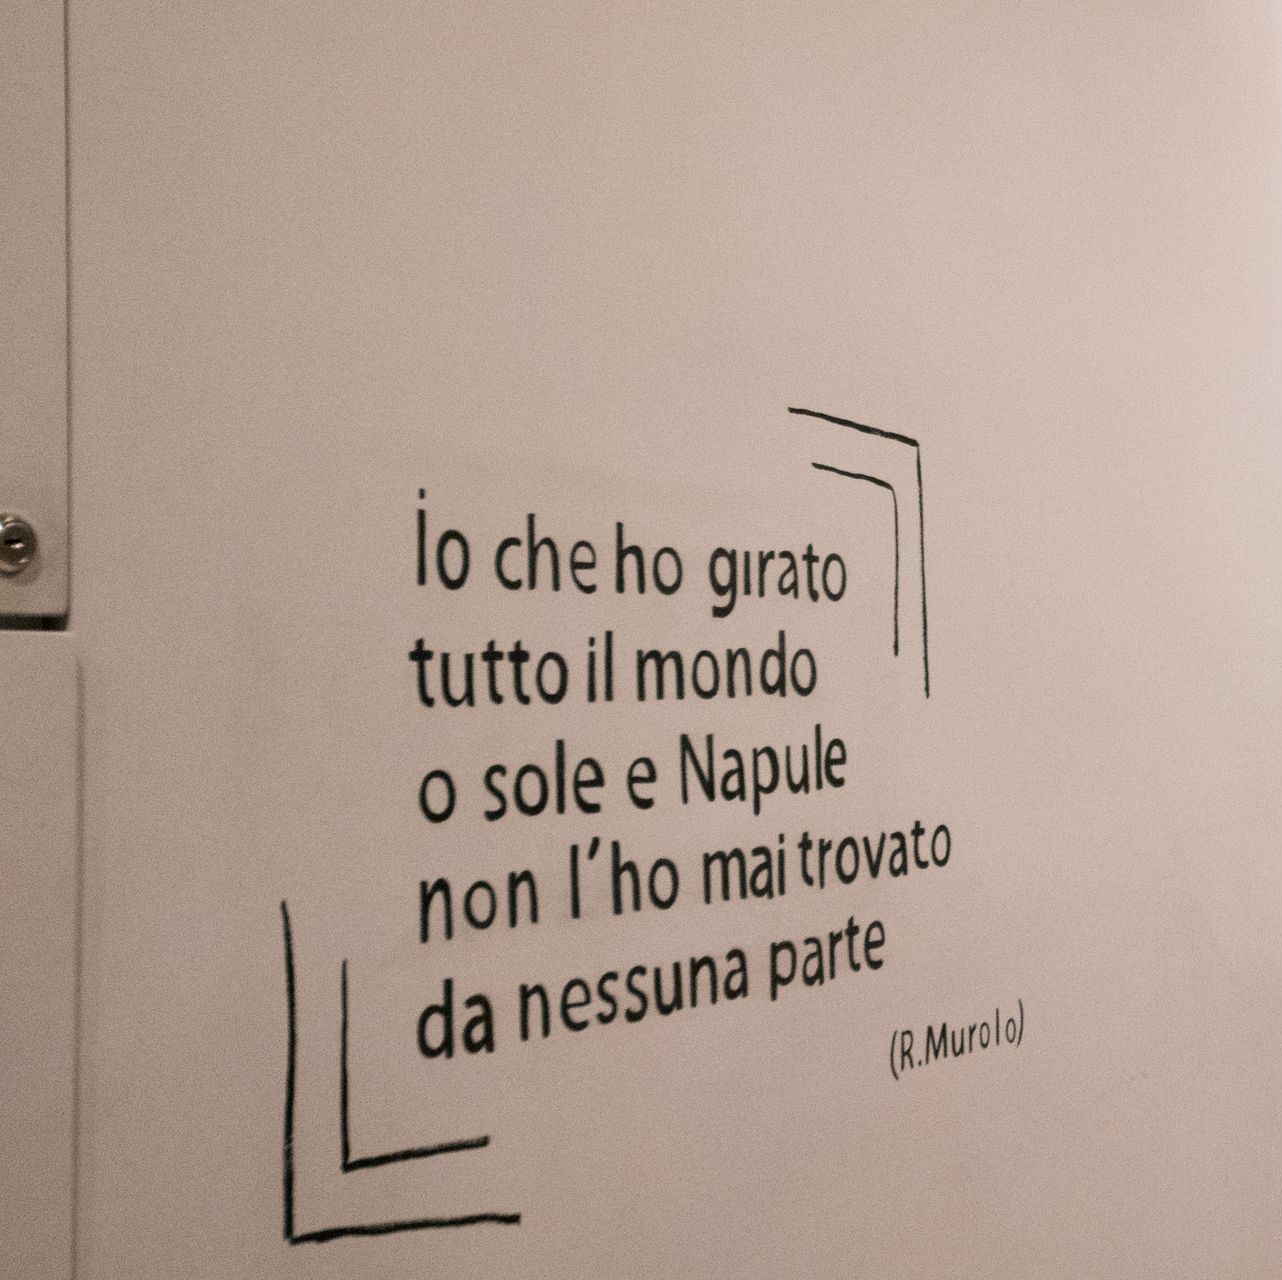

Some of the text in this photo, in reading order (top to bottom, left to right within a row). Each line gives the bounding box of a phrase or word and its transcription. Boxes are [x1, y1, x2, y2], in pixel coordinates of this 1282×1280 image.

[494, 512, 598, 595] che
[615, 521, 684, 596] ho
[408, 629, 818, 709] tutto il mondo
[418, 723, 847, 824] o sole e Napule
[419, 820, 952, 945] non l'ho mai trovato
[416, 916, 886, 1060] da nessuna parte
